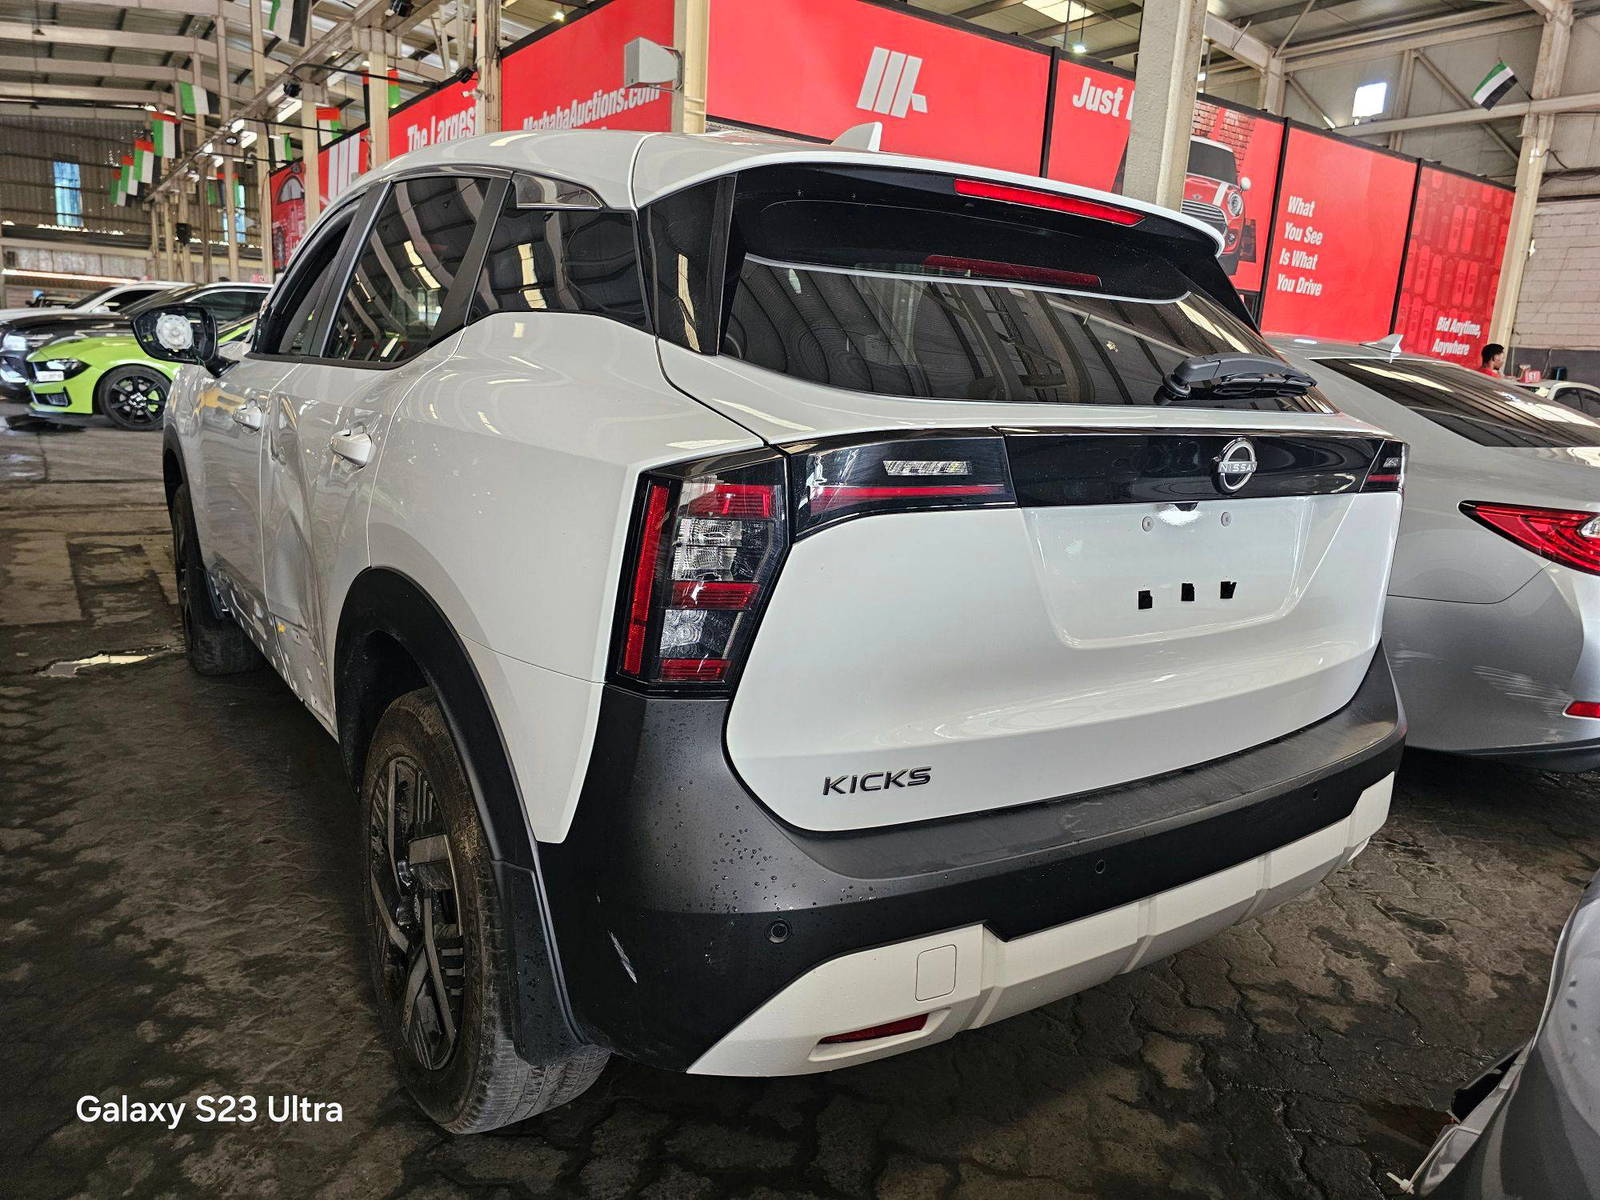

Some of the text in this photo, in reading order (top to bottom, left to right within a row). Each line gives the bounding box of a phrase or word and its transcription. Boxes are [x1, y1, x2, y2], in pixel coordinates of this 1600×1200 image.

[1072, 76, 1124, 117] Just
[407, 124, 428, 152] The
[1287, 195, 1315, 217] What
[1284, 222, 1323, 245] You See
[1279, 247, 1318, 270] Is What
[1276, 273, 1323, 296] You Drive
[1435, 316, 1481, 338] Bid Anytime,
[1432, 338, 1470, 356] Anywhere
[1219, 463, 1256, 473] NISSAN
[822, 766, 932, 795] KICKS
